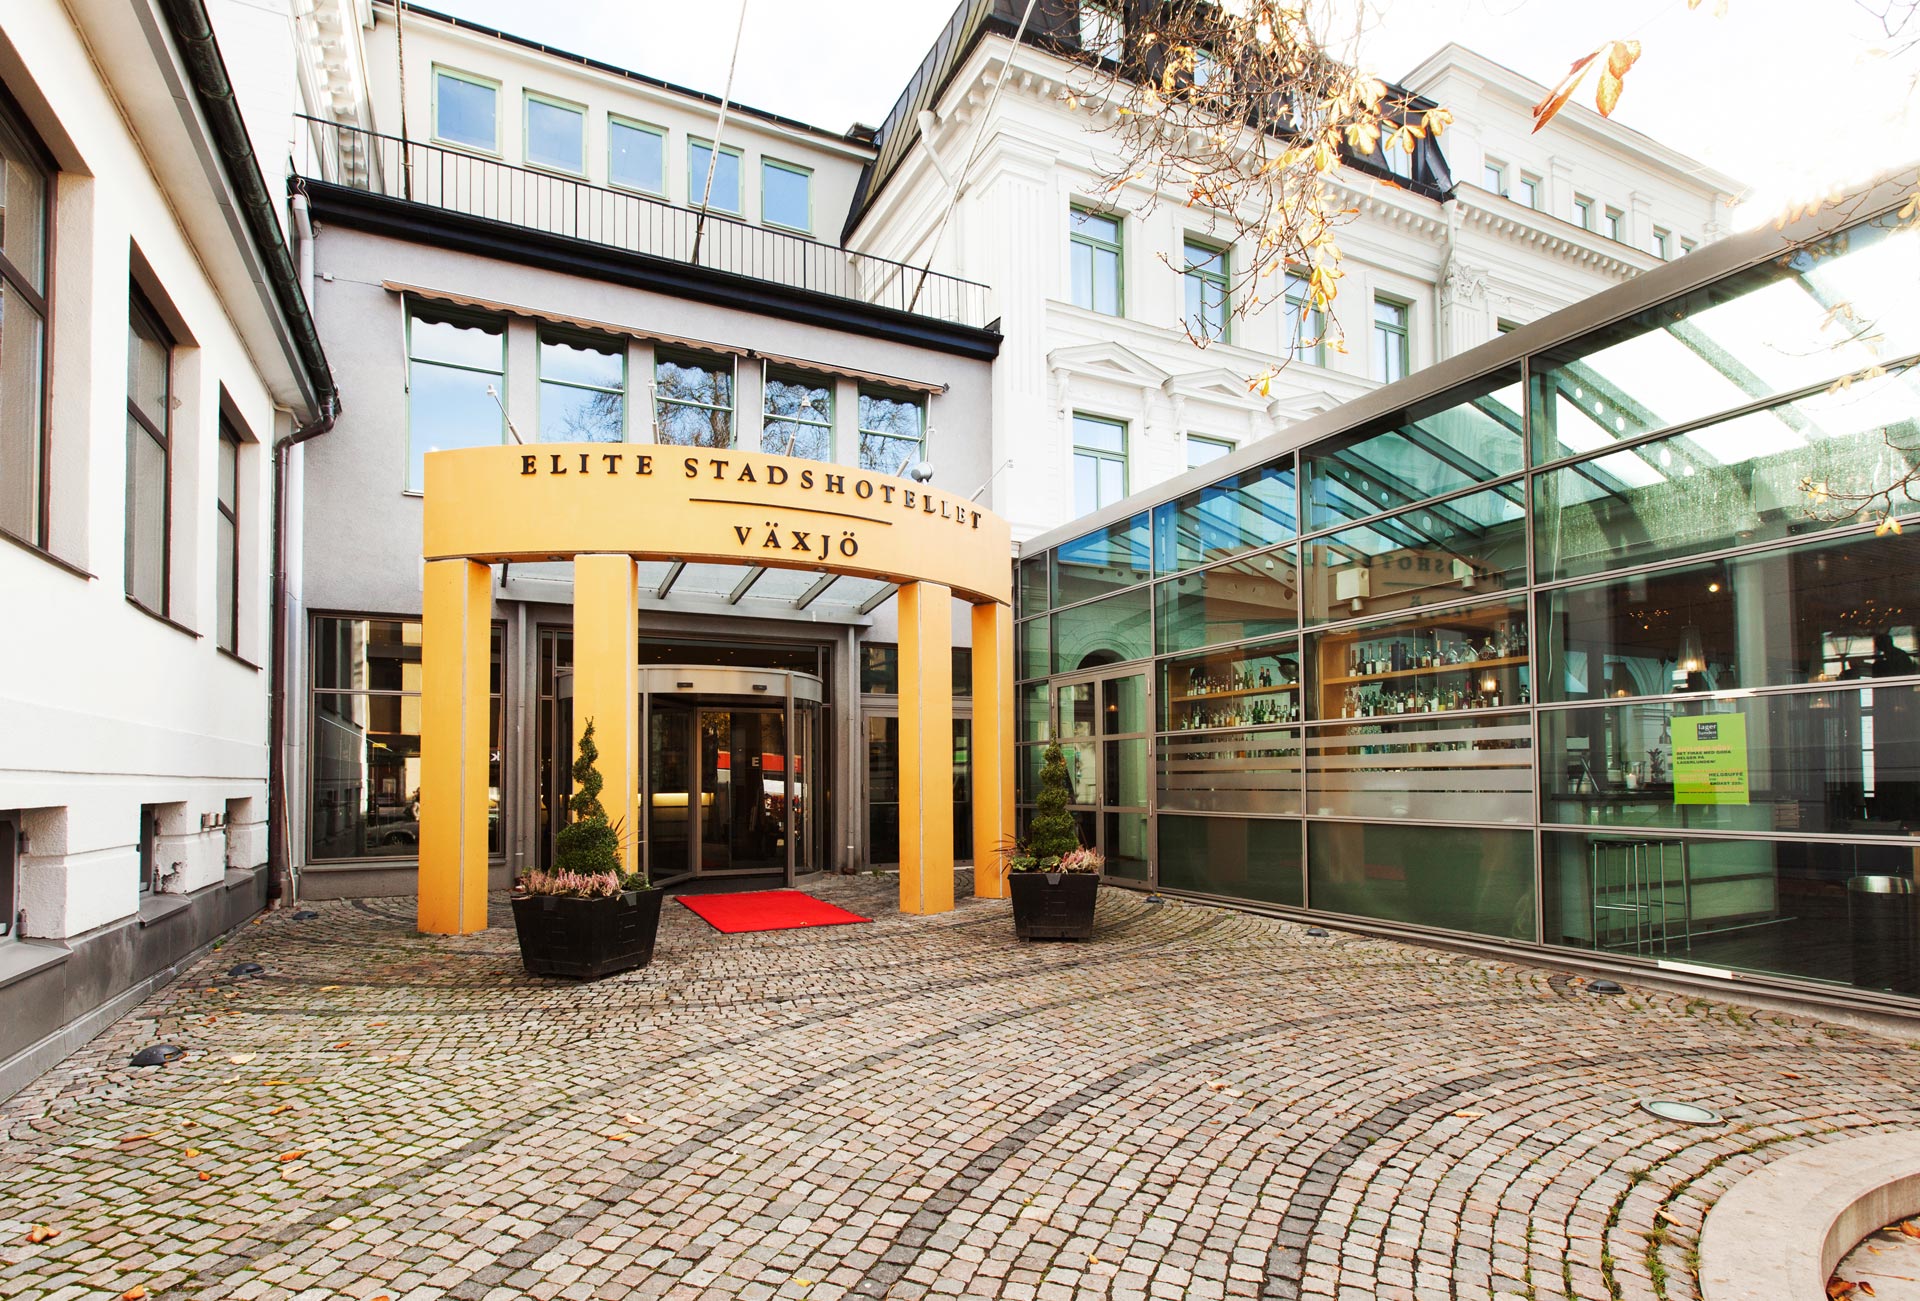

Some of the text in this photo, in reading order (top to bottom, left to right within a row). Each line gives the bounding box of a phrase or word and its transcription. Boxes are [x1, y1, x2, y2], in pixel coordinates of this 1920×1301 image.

[520, 453, 982, 529] ELITE STADSHOTELLET
[734, 521, 859, 561] VÄXJÖ
